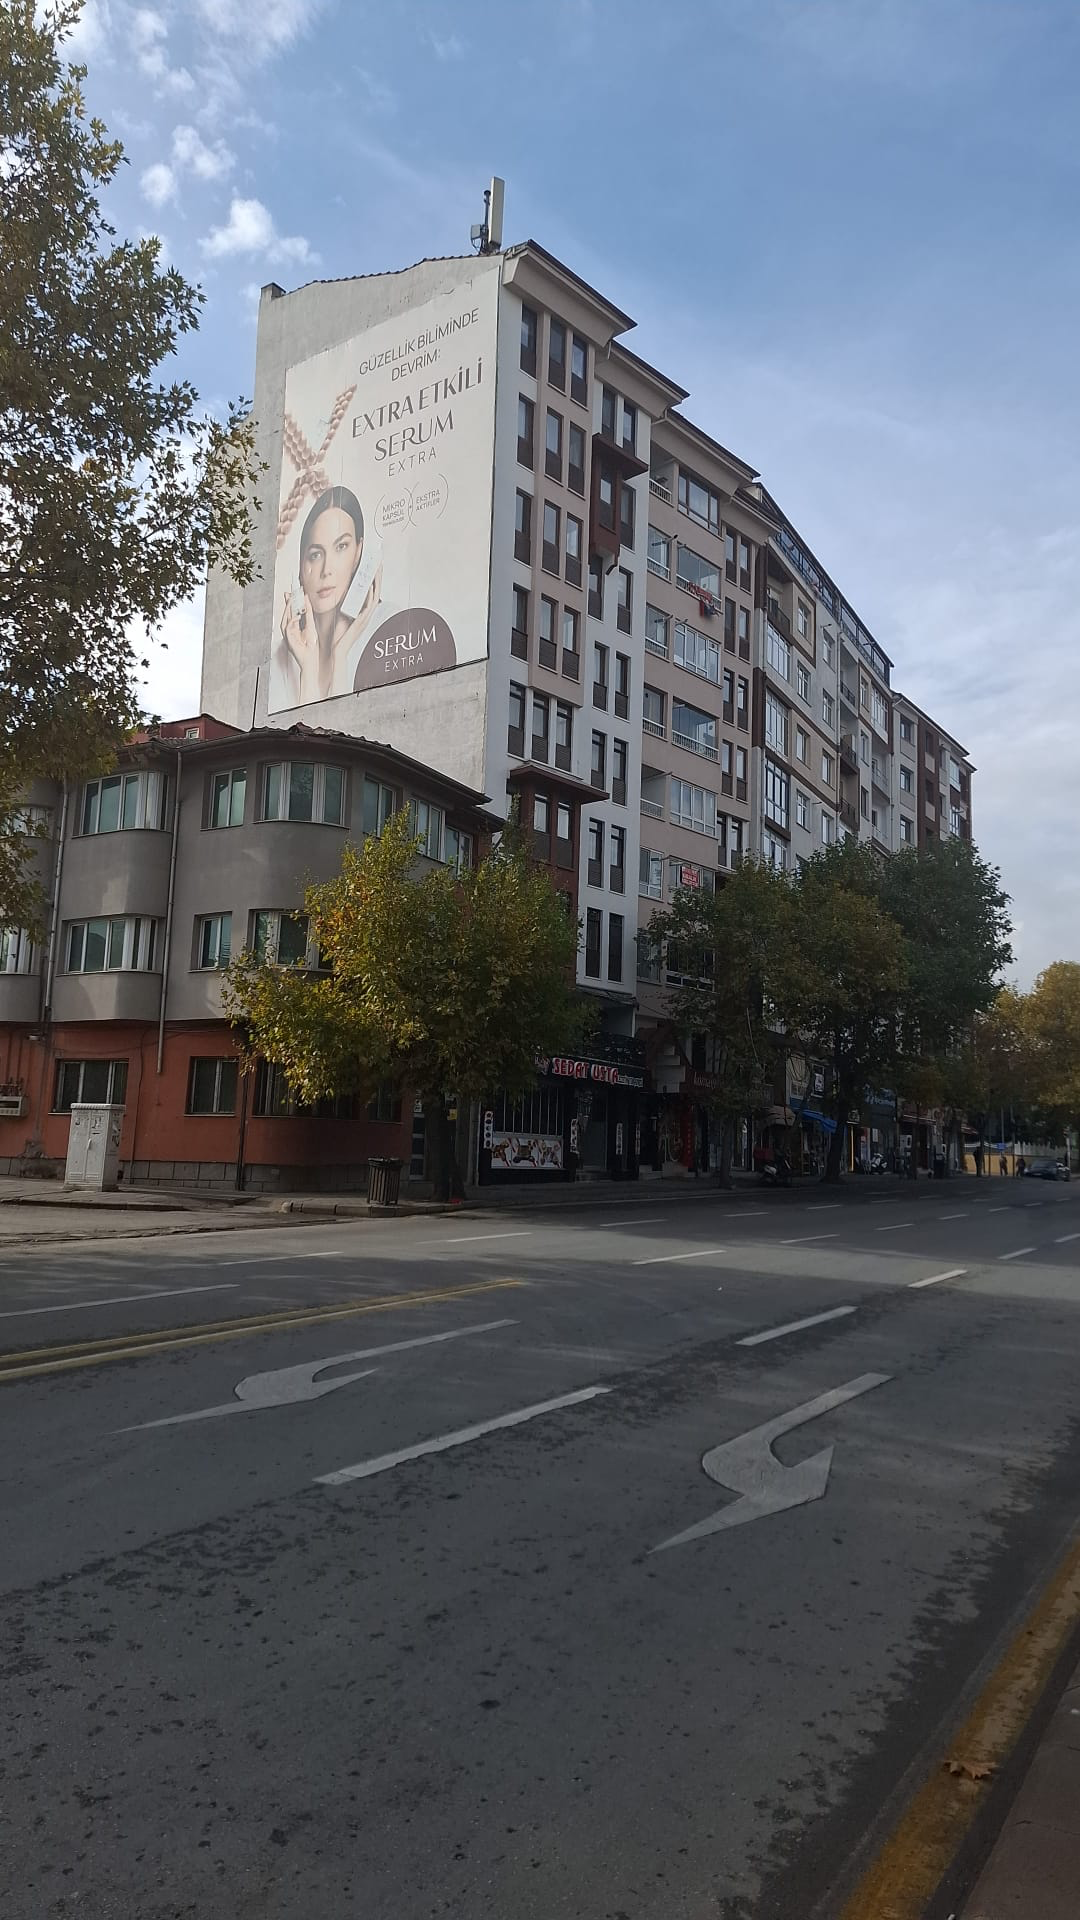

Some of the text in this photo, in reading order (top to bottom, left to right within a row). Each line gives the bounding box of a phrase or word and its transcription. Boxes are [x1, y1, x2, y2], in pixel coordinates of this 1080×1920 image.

[359, 308, 480, 375] GÜZELLİK BİLİMİNDE
[391, 348, 441, 382] DEVRİM:
[352, 357, 483, 439] EXTRA ETKİLİ
[374, 409, 455, 462] SERUM
[388, 446, 437, 477] EXTRA
[416, 488, 441, 504] EKSTRA
[373, 624, 438, 660] SERUM
[384, 652, 424, 673] EXTRA
[552, 1057, 590, 1079] SEDAT
[591, 1063, 619, 1085] USTA
